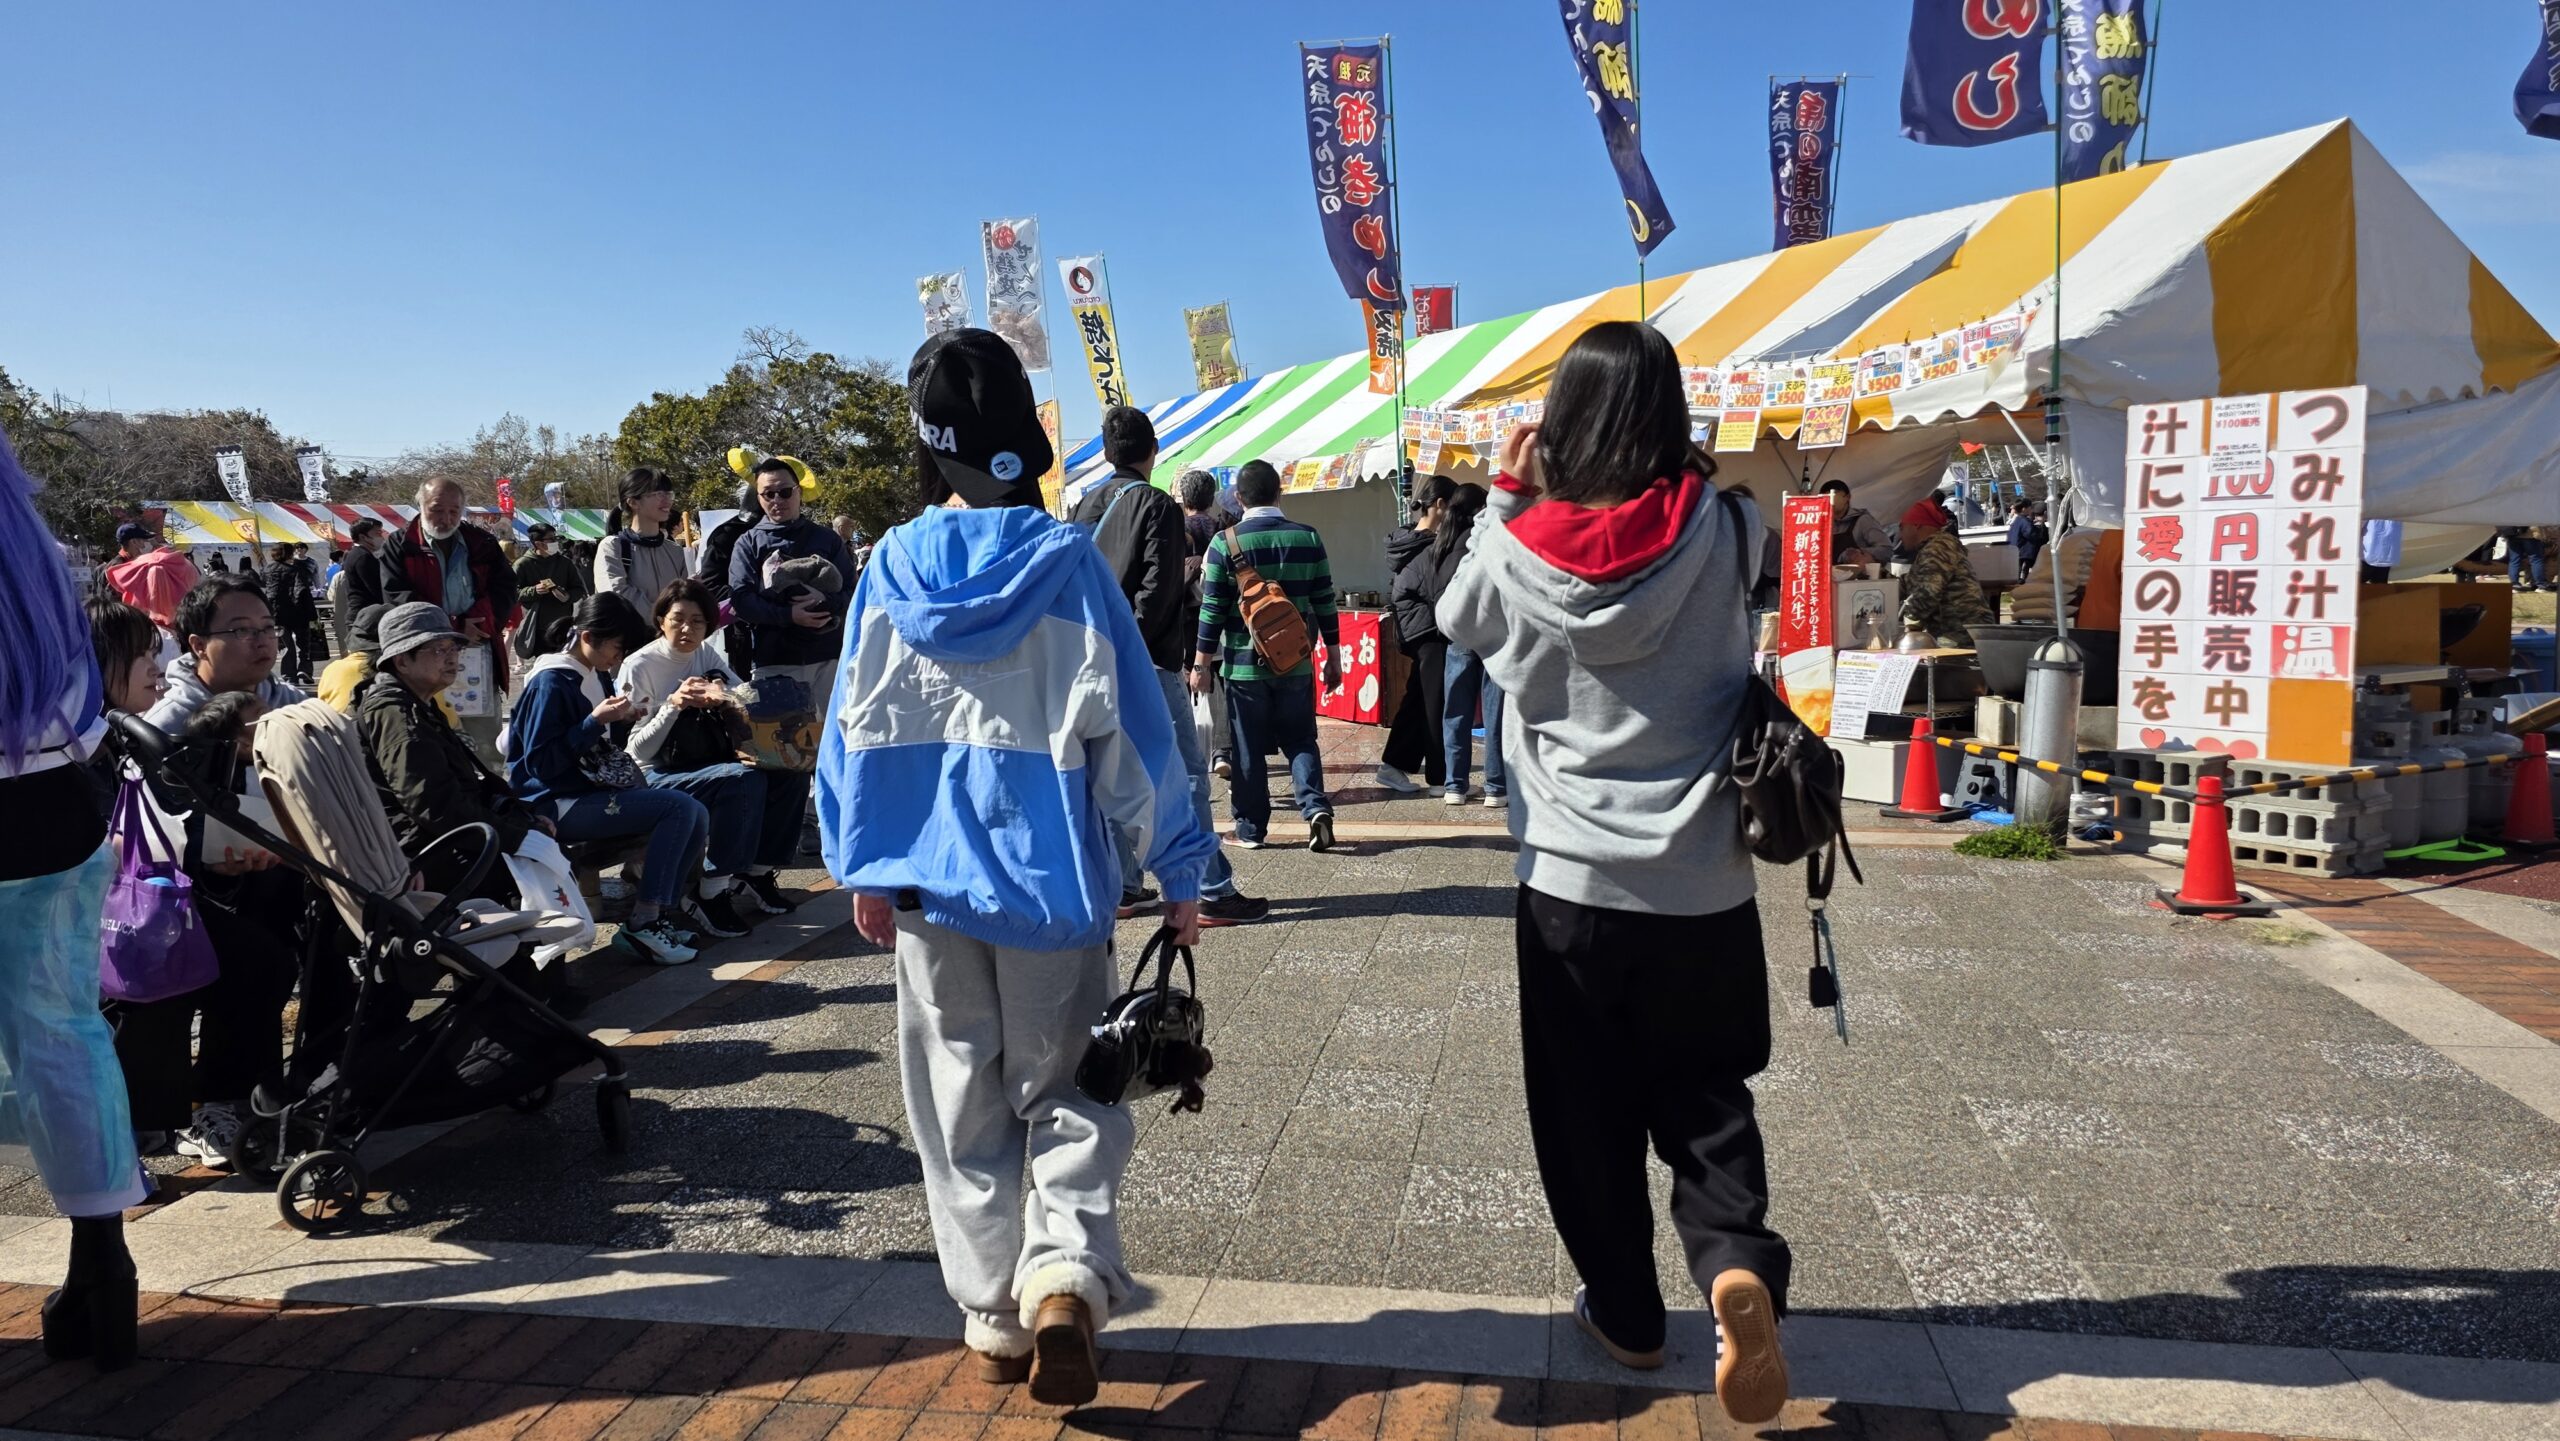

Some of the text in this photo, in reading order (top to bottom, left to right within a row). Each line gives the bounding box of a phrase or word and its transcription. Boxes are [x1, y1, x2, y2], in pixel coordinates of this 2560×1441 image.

[1923, 360, 1958, 379] ¥500
[1868, 374, 1901, 391] ¥500
[1777, 391, 1805, 404] ¥500
[1823, 385, 1852, 399] ¥500
[1695, 394, 1720, 407] ¥200
[1735, 394, 1761, 407] ¥500
[2282, 394, 2349, 676] つみれ汁 温
[2132, 406, 2188, 722] 汁に愛の手を
